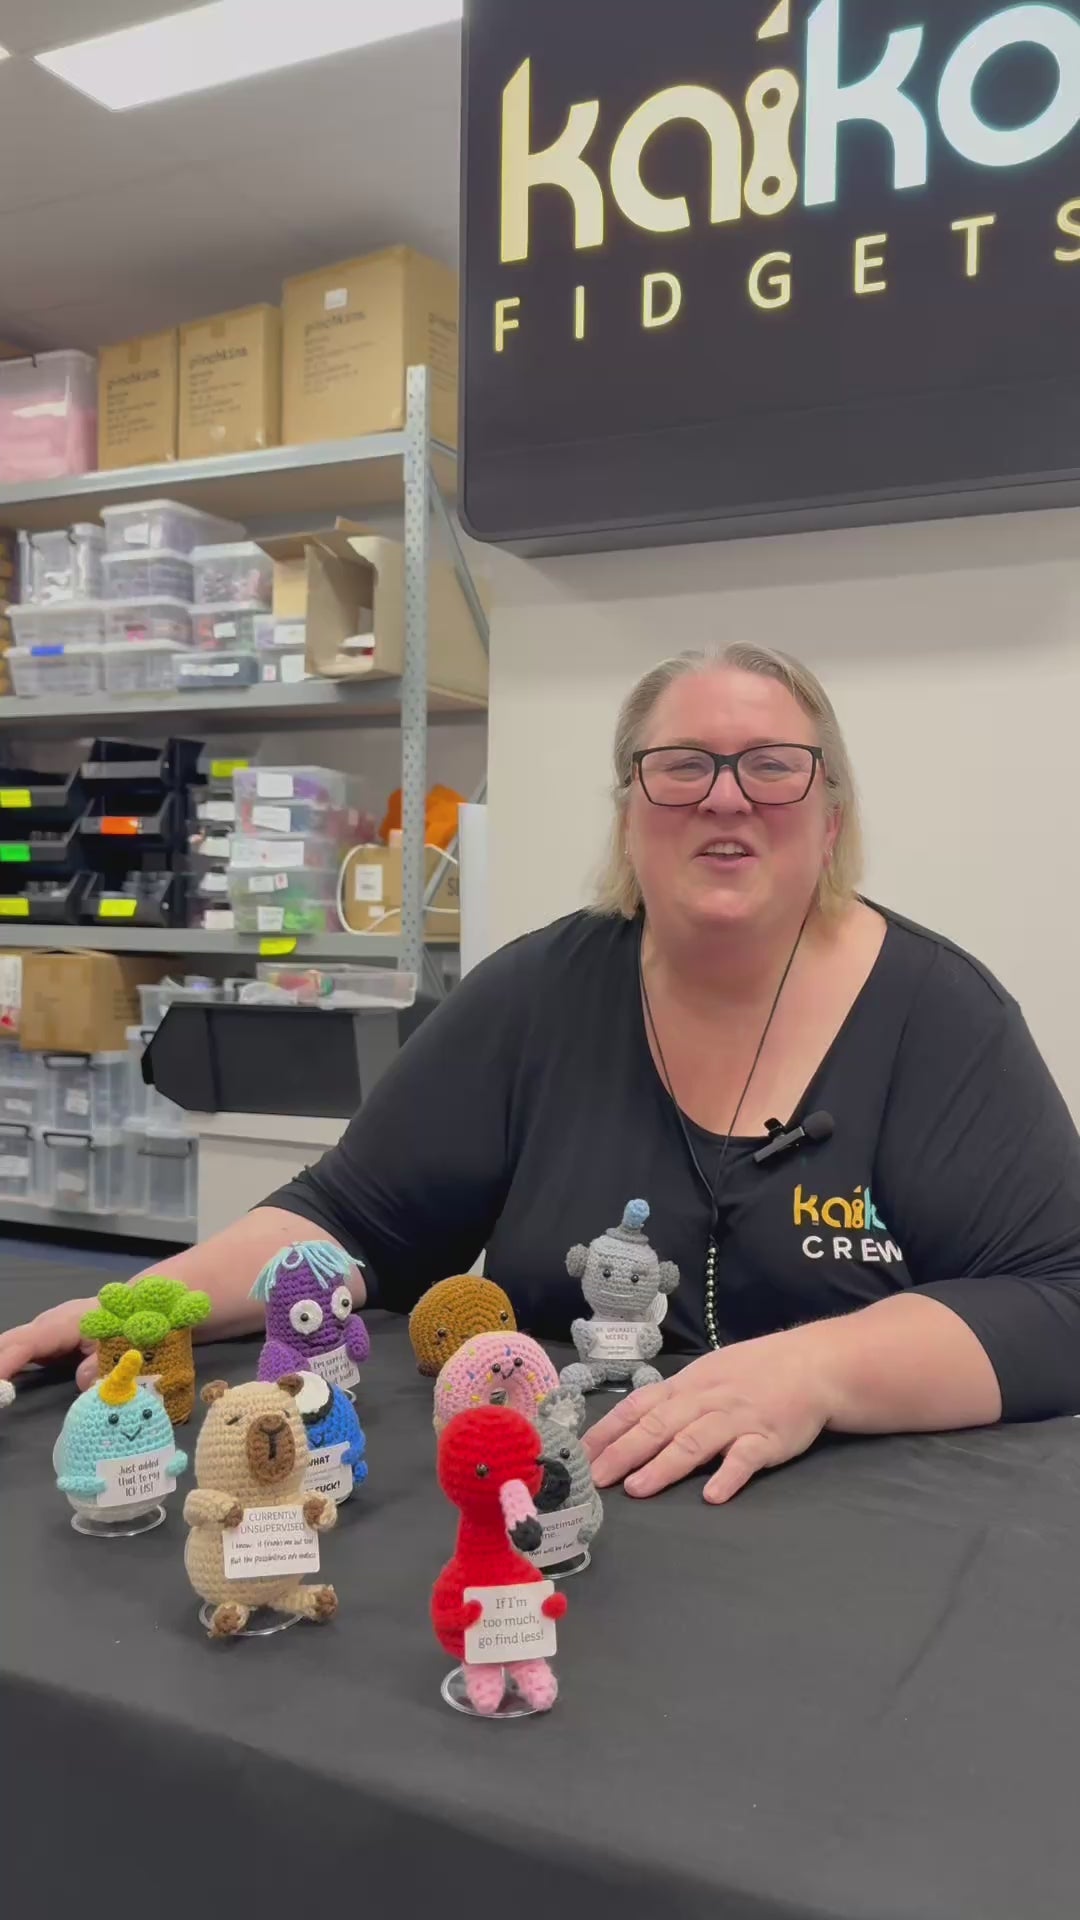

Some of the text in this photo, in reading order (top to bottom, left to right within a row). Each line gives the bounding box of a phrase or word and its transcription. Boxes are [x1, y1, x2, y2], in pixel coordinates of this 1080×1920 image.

[500, 0, 1080, 263] kaiko
[494, 199, 1080, 352] FIDGETS
[793, 1184, 887, 1230] kaik
[802, 1235, 903, 1263] CREW
[119, 1458, 159, 1476] Just added
[248, 1511, 297, 1521] CURRENTLY
[543, 1517, 583, 1531] restimate
[240, 1522, 304, 1534] UNSUPERVISED
[496, 1596, 527, 1609] If I'm
[483, 1611, 540, 1628] too much,
[478, 1628, 545, 1649] go find less!
